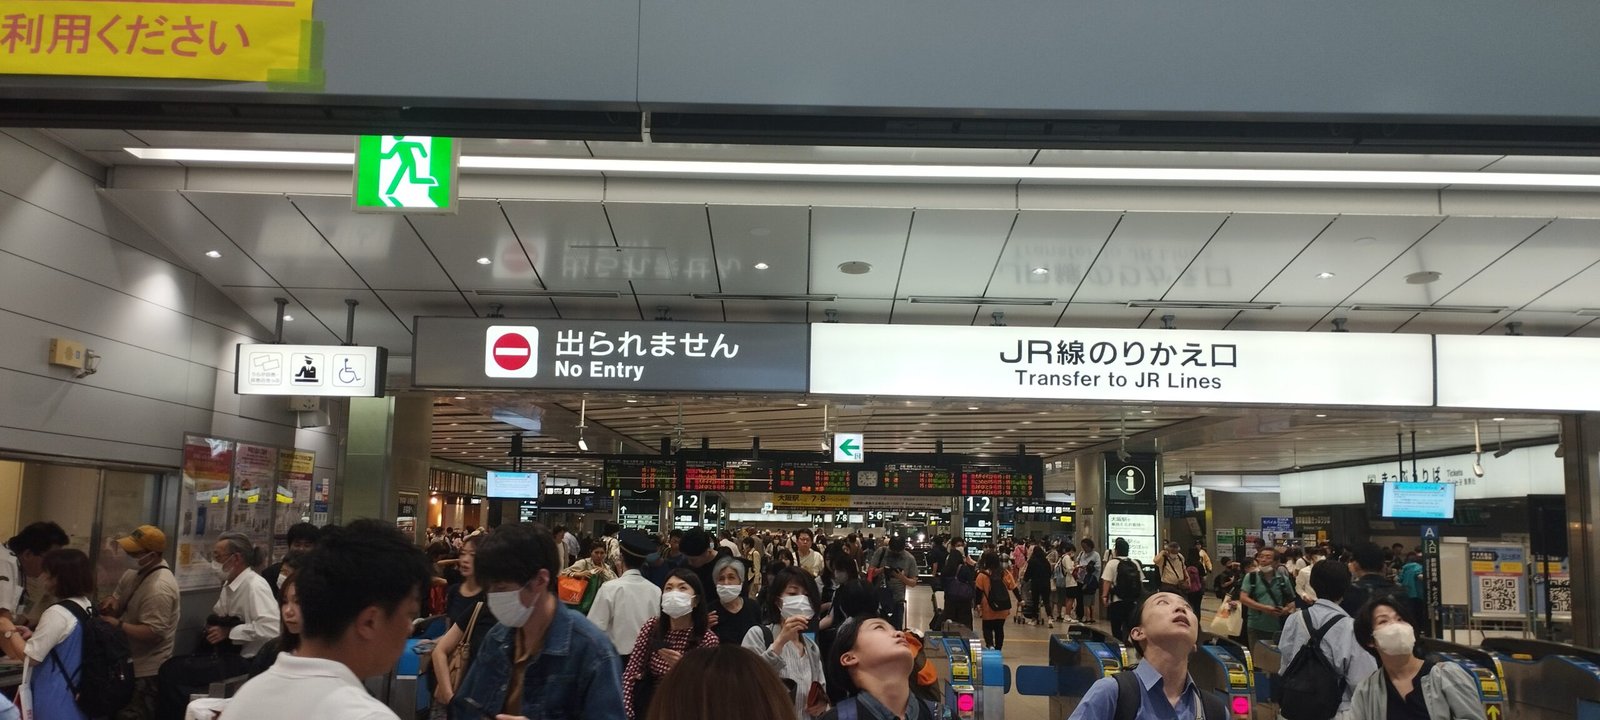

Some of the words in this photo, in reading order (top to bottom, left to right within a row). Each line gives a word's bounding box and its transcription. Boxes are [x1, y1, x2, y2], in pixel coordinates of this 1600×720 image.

[0, 13, 250, 57] 利用ください
[556, 329, 739, 358] 出られません
[999, 339, 1237, 368] JR線のりかえ口
[555, 361, 583, 377] No
[590, 361, 645, 382] Entry
[1015, 369, 1101, 387] Transfer
[1108, 372, 1127, 387] to
[1135, 372, 1160, 388] JR
[1168, 372, 1222, 389] Lines
[1381, 466, 1441, 482] きっぷりば
[1425, 527, 1435, 537] A
[1428, 540, 1437, 554] 入口
